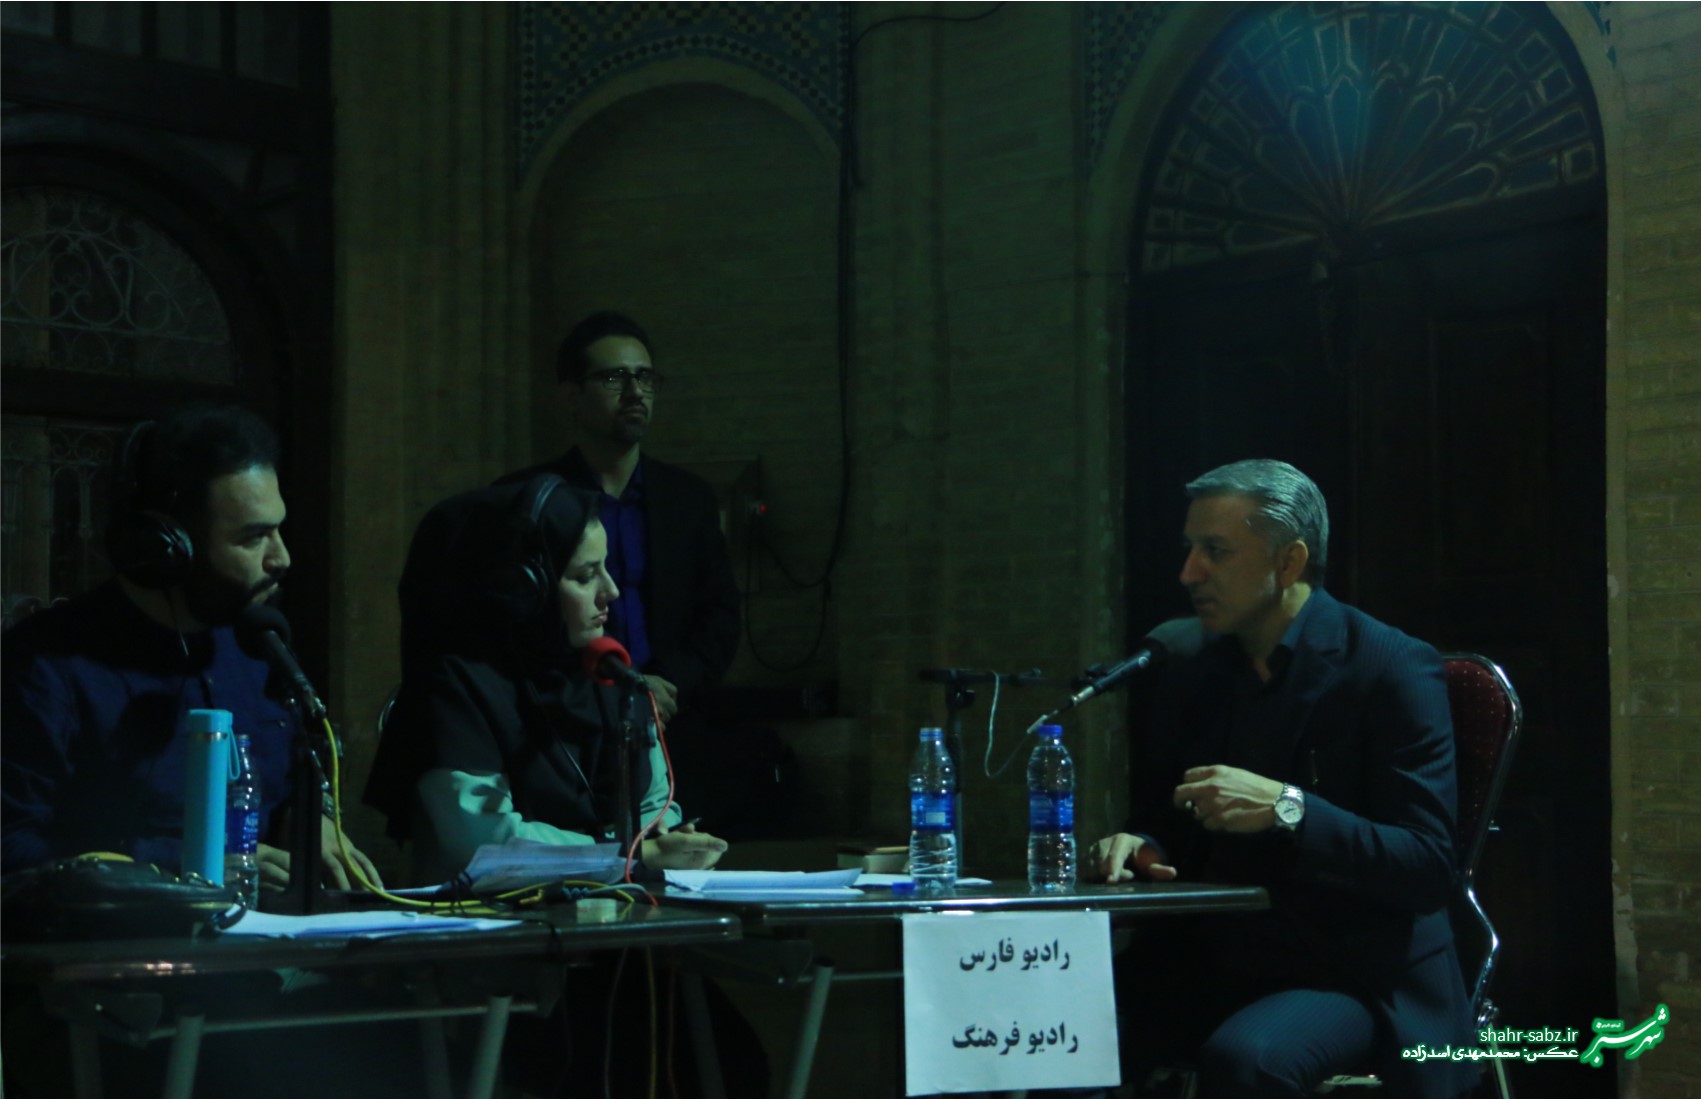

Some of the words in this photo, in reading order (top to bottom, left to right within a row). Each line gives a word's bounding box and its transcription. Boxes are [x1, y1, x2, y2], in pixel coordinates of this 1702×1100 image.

[959, 937, 1015, 972] فارس
[1020, 938, 1070, 971] رادیو
[952, 1021, 1021, 1055] فرهنگ
[1026, 1021, 1078, 1054] رادیو
